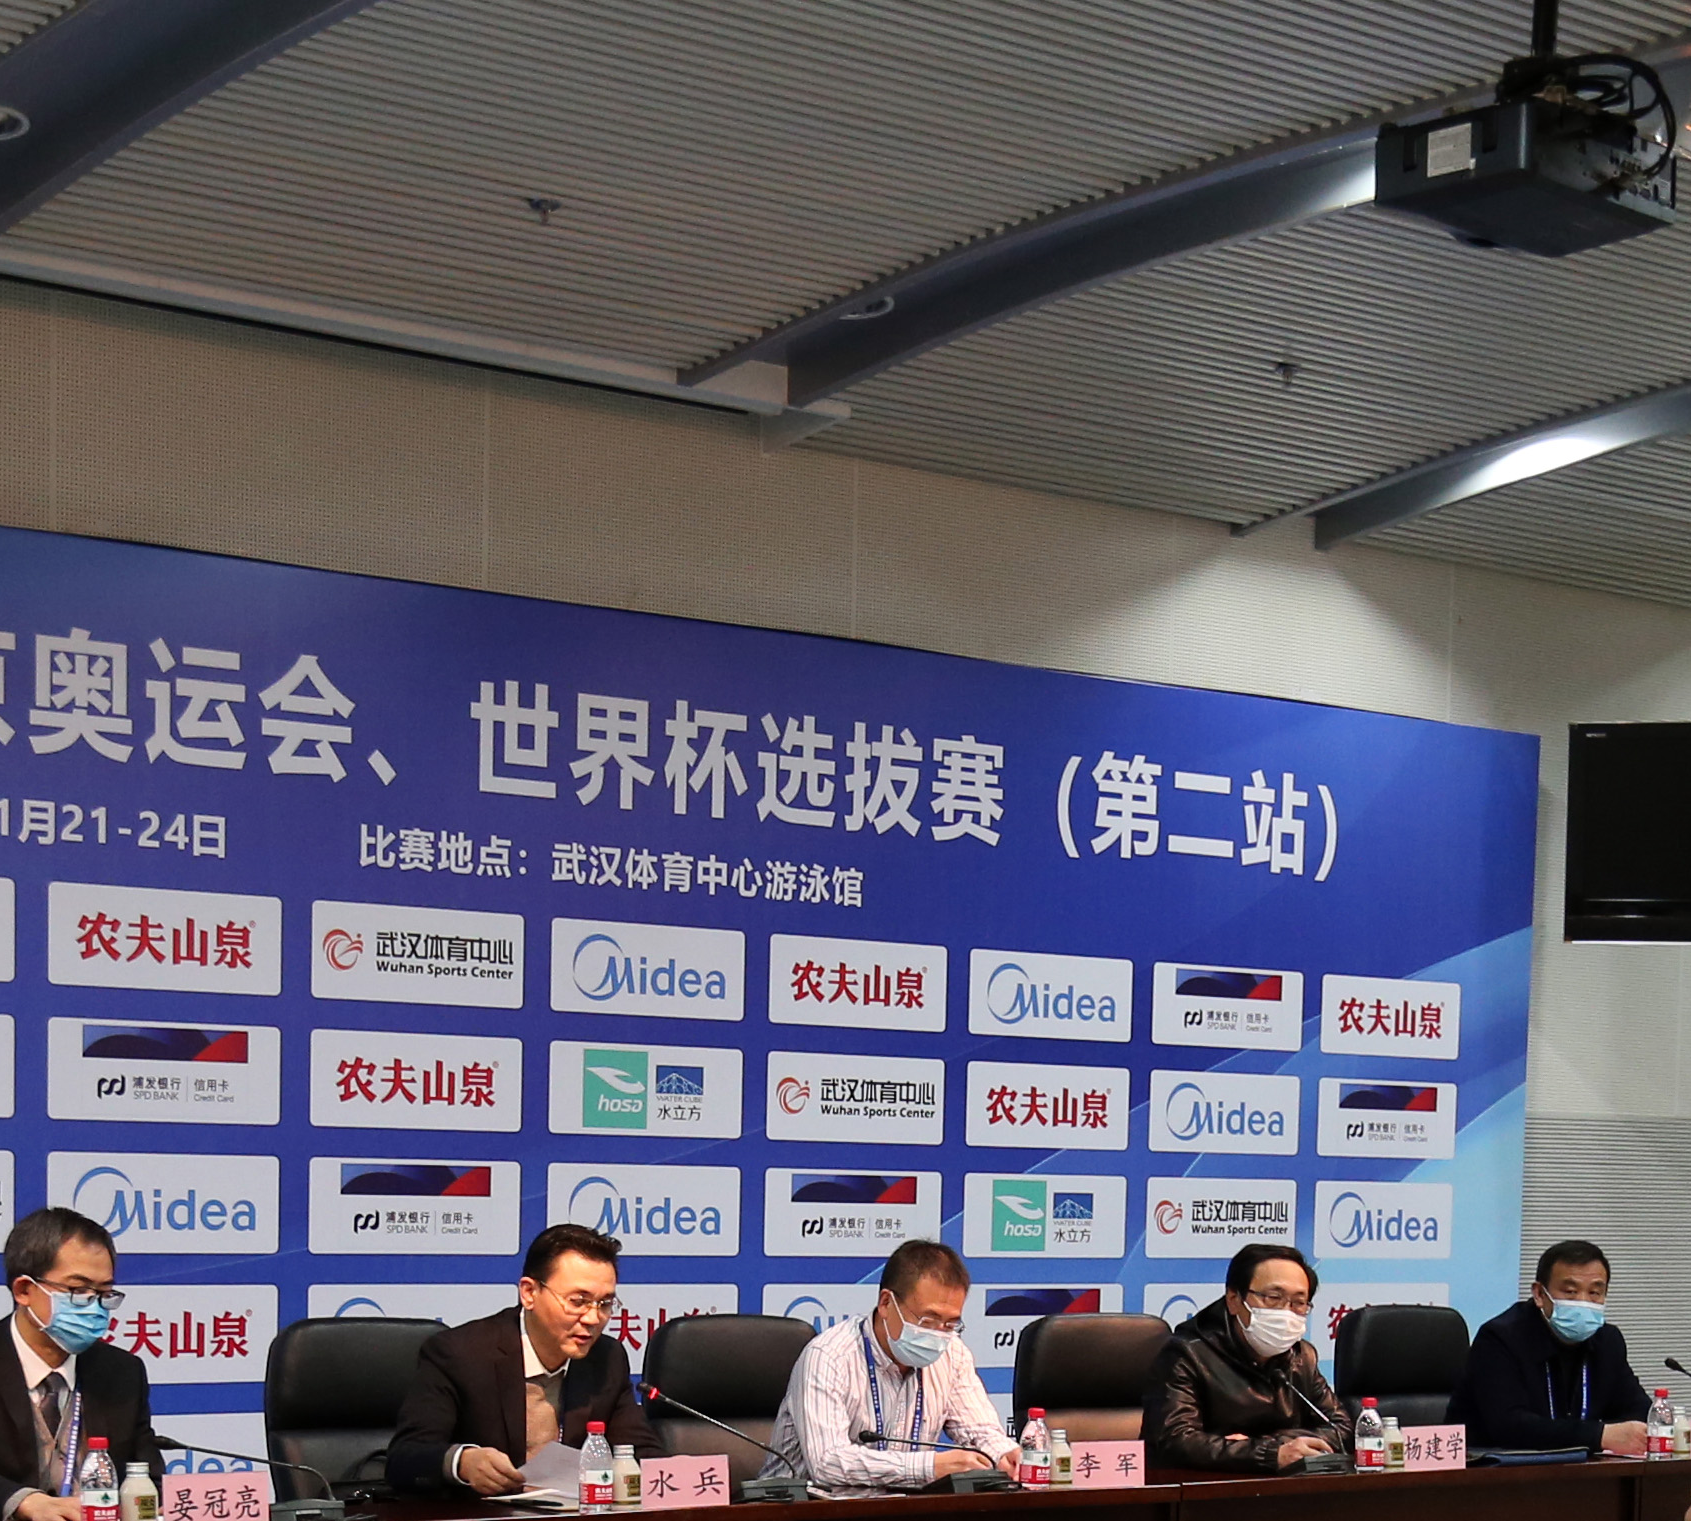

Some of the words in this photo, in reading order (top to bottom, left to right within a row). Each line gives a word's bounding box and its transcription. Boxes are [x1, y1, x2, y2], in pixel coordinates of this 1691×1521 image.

[76, 912, 253, 970] 农夫山泉
[376, 930, 514, 966] 武汉体育中心
[376, 961, 424, 976] Wuhan
[427, 963, 468, 980] Sports
[471, 965, 514, 980] Center
[573, 933, 726, 1001] Midea
[790, 960, 925, 1010] 农夫山泉
[987, 962, 1116, 1025] Midea
[1338, 997, 1443, 1041] 农夫山泉
[132, 1076, 182, 1091] 浦发银行
[193, 1079, 229, 1093] 信用卡
[336, 1057, 497, 1108] 农夫山泉
[821, 1078, 936, 1106] 武汉体育中心
[597, 1094, 644, 1113] hosa
[657, 1104, 701, 1121] 水立方
[821, 1104, 860, 1116] Wuhan
[863, 1106, 897, 1119] Sports
[900, 1107, 936, 1118] Center
[987, 1085, 1109, 1130] 农夫山泉
[1166, 1082, 1284, 1141] Midea
[74, 1166, 257, 1239] Midea
[569, 1176, 722, 1237] Midea
[1192, 1199, 1289, 1222] 武汉体育中心
[1329, 1191, 1438, 1247] Midea
[1004, 1220, 1042, 1237] hosa
[1054, 1228, 1091, 1243] 水立方
[1191, 1224, 1225, 1234] Wuhan
[1227, 1224, 1256, 1236] Sports
[1258, 1225, 1288, 1234] Center
[99, 1310, 250, 1359] 夫山泉
[1404, 1432, 1464, 1461] 杨建学
[168, 1485, 261, 1521] 晏冠亮
